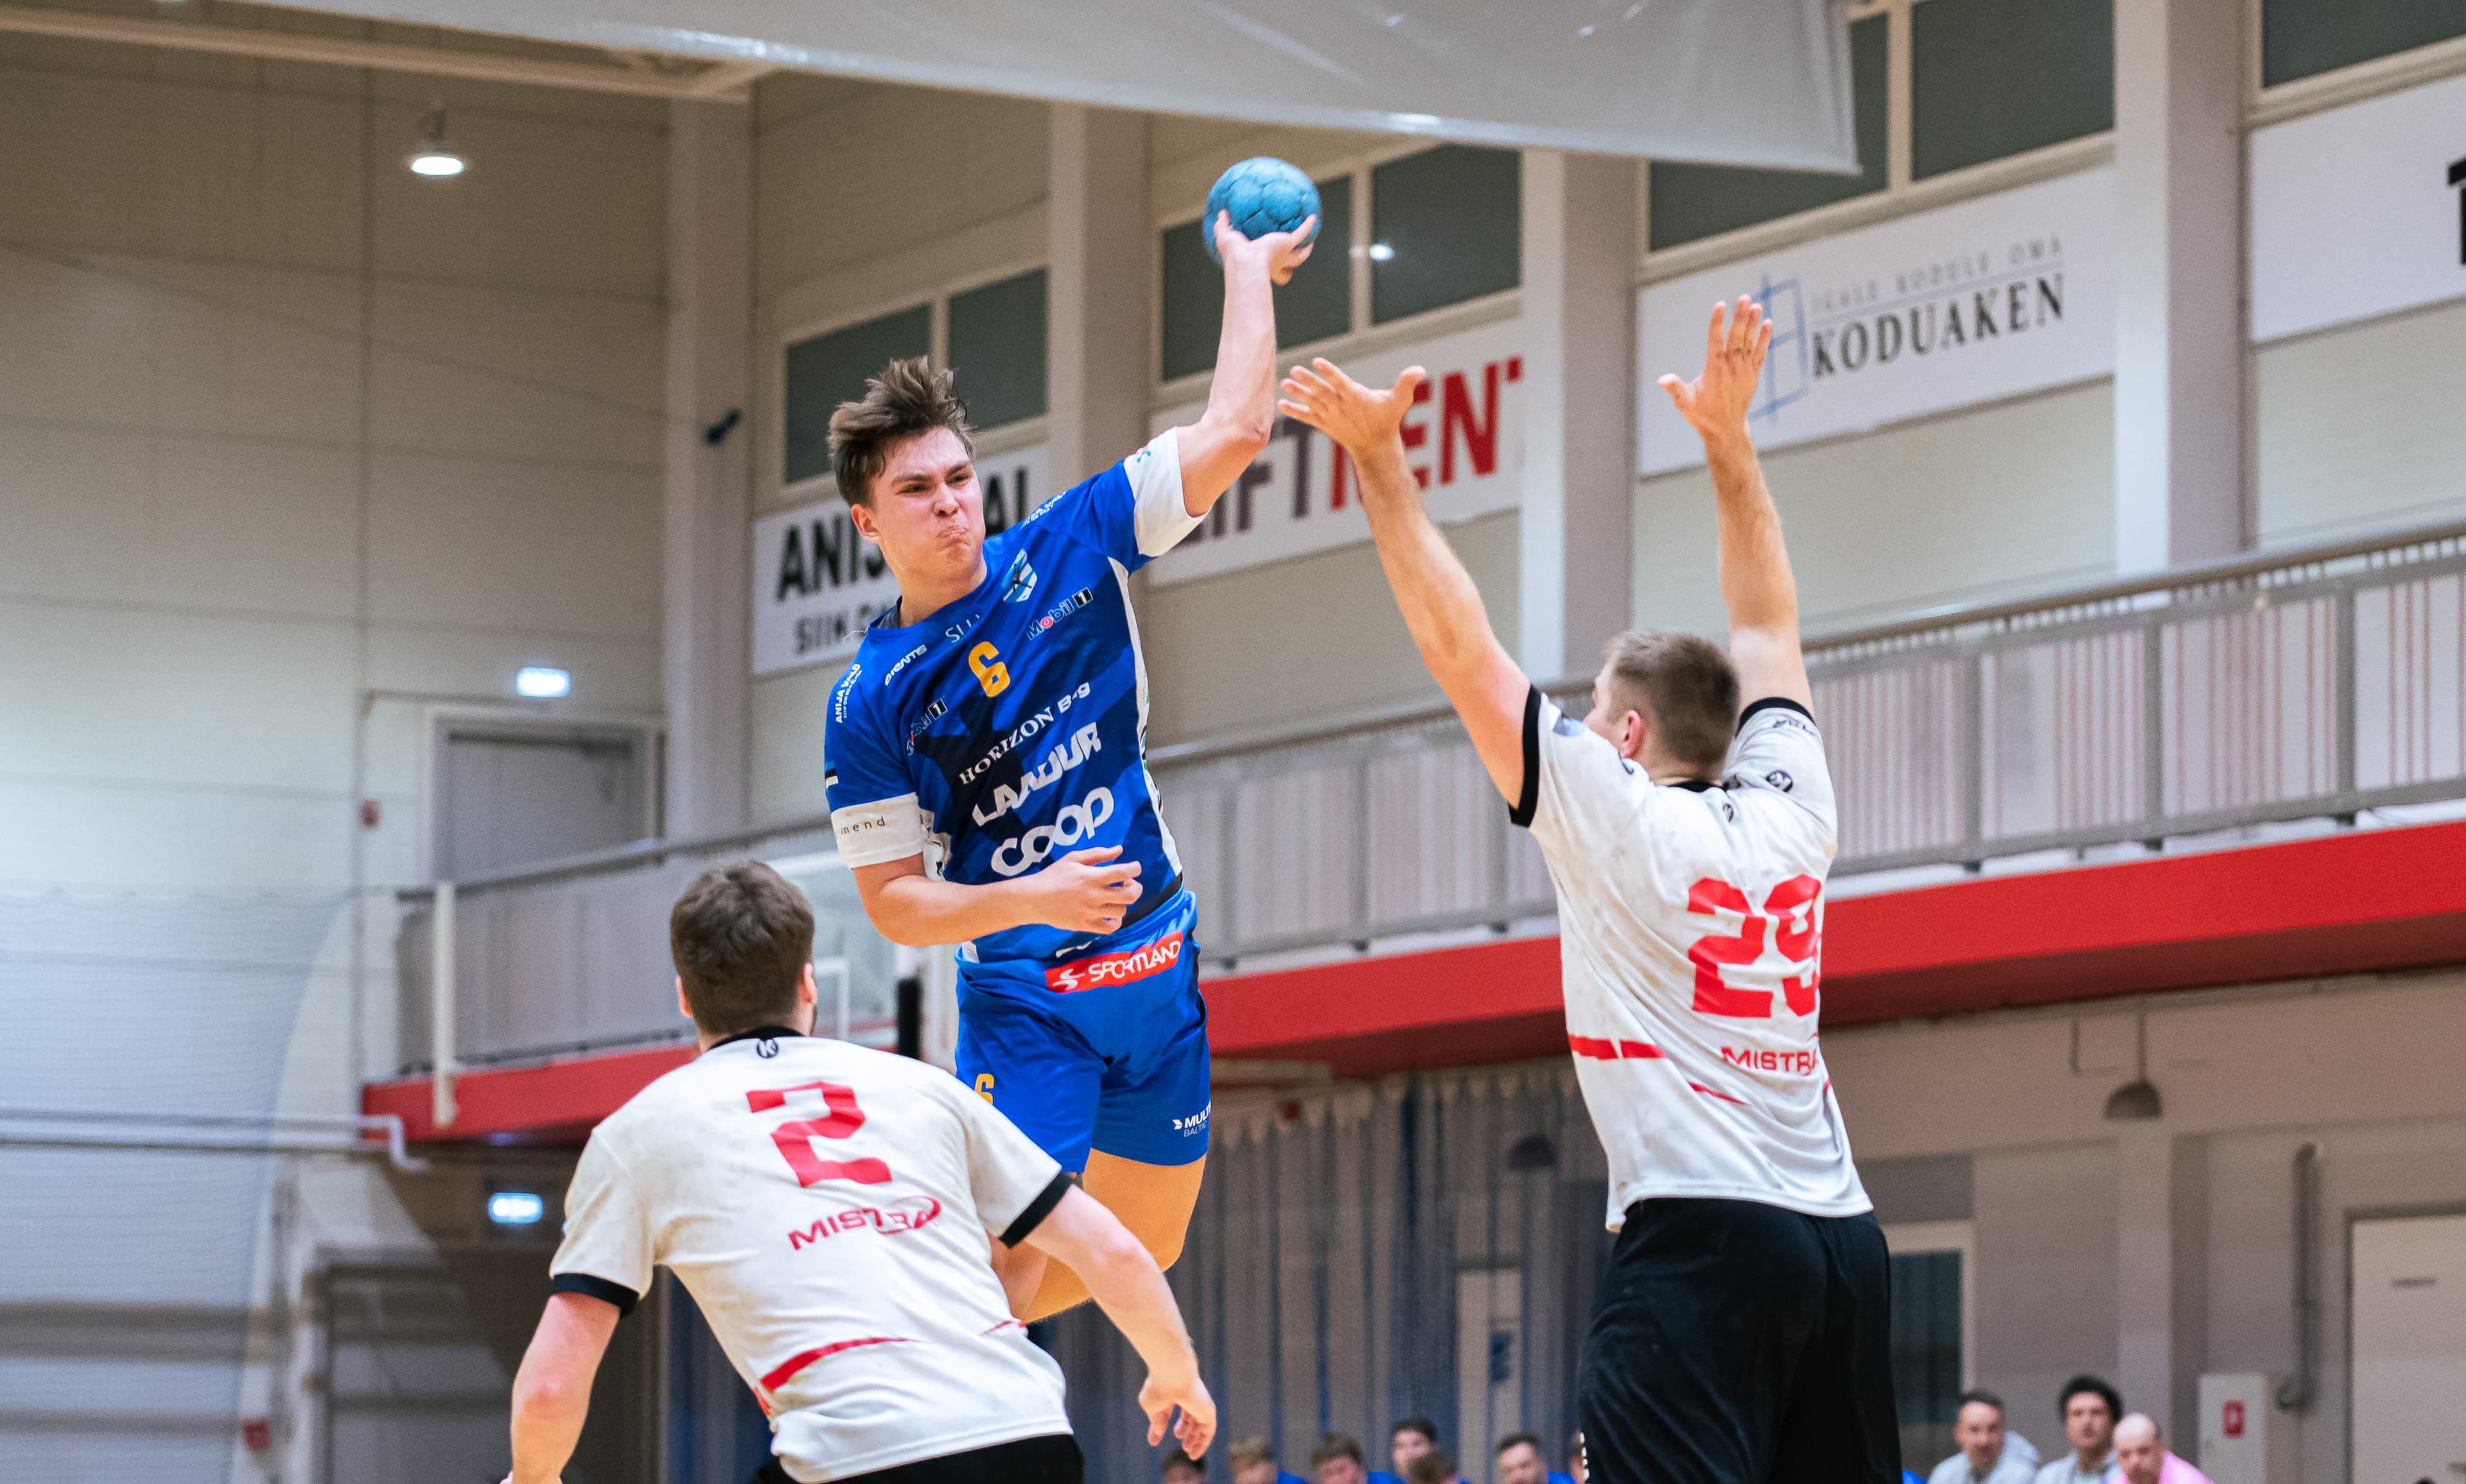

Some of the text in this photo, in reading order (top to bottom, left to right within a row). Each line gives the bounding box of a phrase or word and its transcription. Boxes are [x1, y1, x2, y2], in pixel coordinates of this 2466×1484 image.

[2009, 236, 2063, 265] OMA
[1812, 272, 2064, 378] KODUAKEN
[775, 512, 888, 604] ANIJ
[1026, 598, 1075, 641] Mobil
[835, 689, 846, 724] ANIJA
[968, 641, 1010, 697] 6
[959, 706, 1054, 785] HORIZON
[991, 787, 1114, 877] COOP
[1089, 940, 1181, 982] SPORTLAND
[1686, 873, 1822, 1020] 29
[745, 1080, 893, 1188] 2
